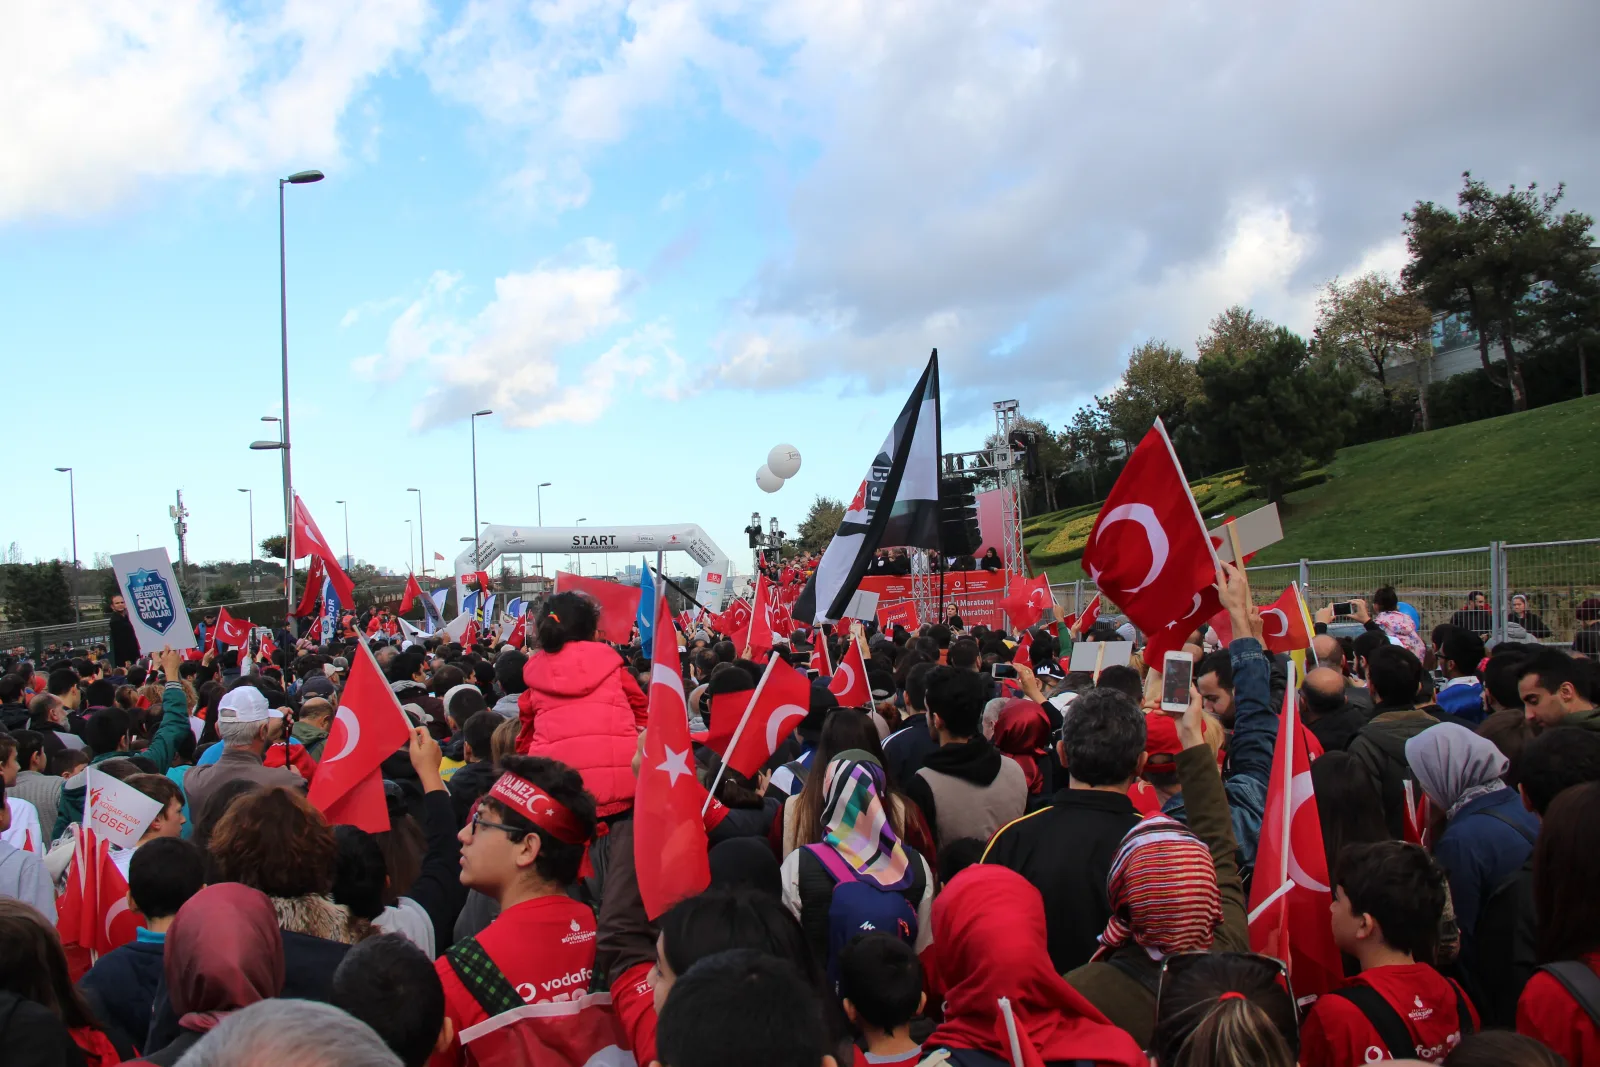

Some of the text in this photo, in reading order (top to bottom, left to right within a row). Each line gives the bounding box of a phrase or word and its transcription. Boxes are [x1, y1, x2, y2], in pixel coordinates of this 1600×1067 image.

[572, 535, 617, 546] START
[137, 597, 169, 612] SPOR
[960, 599, 994, 608] Maratonu
[961, 609, 994, 617] Marathon
[91, 809, 135, 836] LÖSEV
